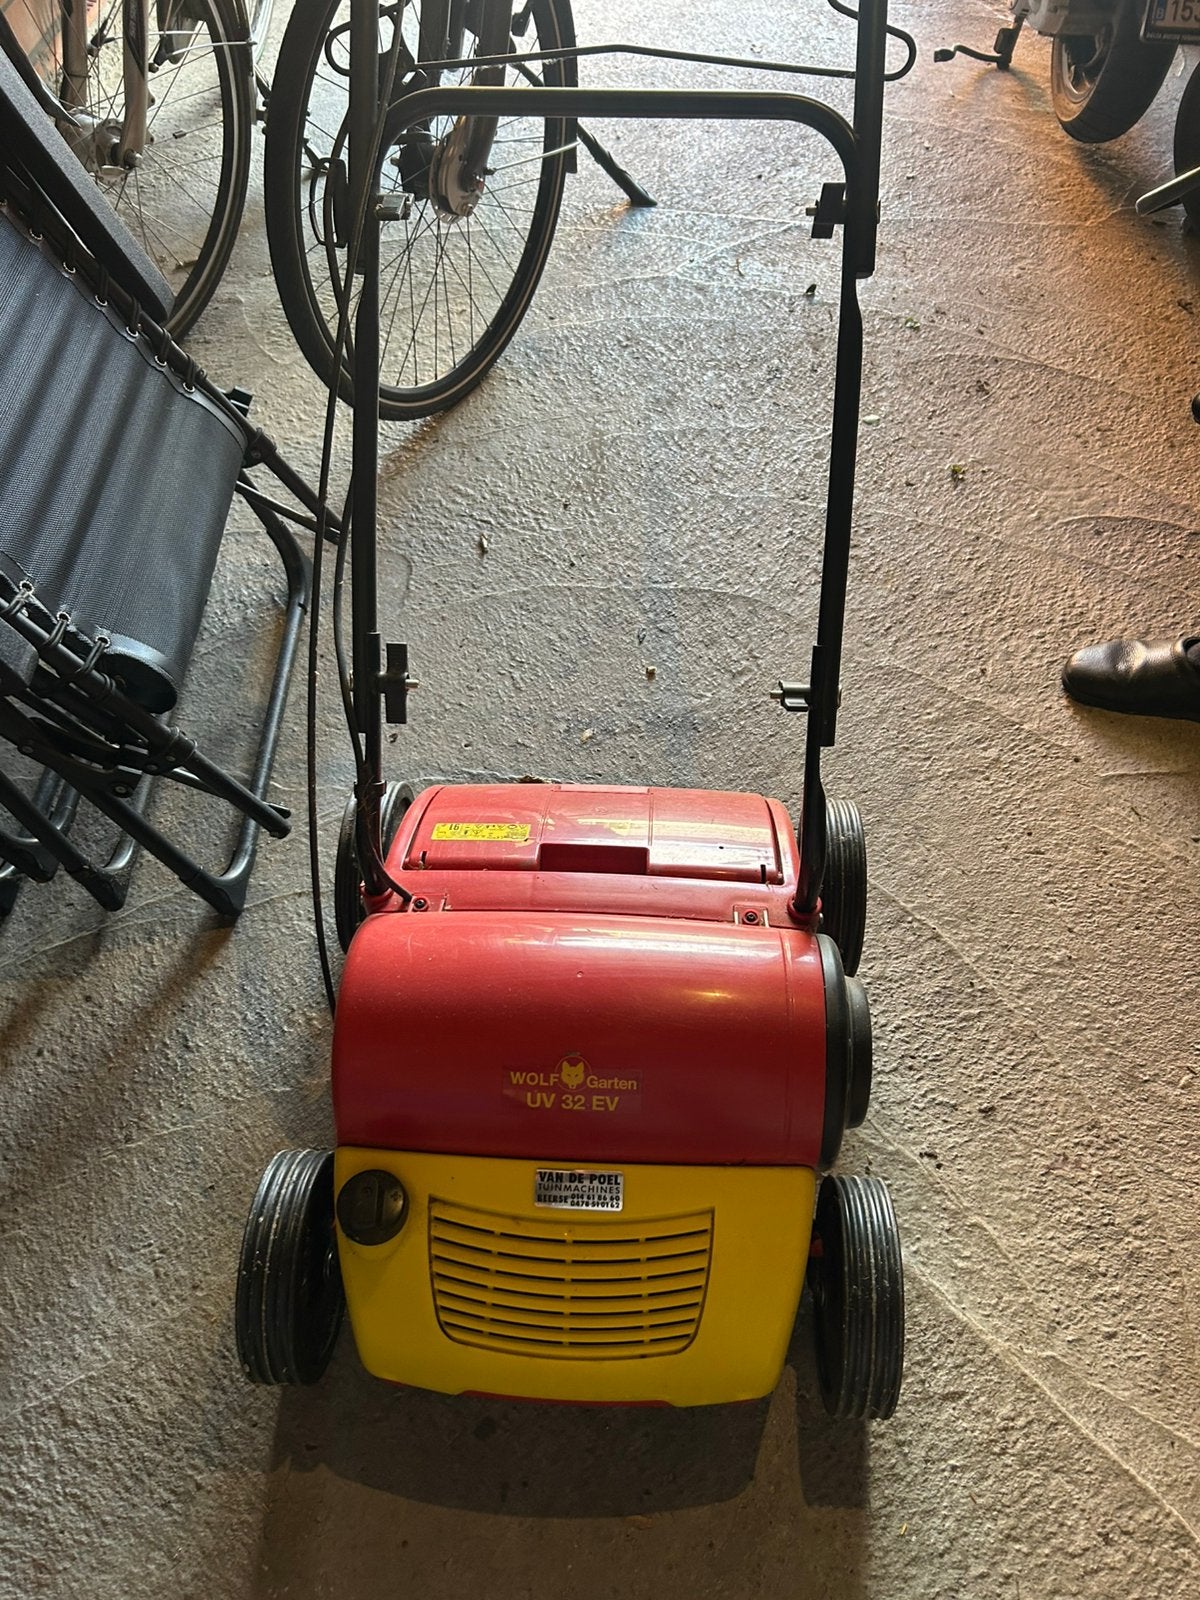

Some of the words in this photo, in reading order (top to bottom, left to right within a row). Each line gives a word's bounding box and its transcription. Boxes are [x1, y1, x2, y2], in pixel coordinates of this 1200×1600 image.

[510, 1071, 560, 1086] WOLF
[586, 1075, 638, 1090] Garten
[526, 1092, 556, 1108] UV
[561, 1094, 586, 1110] 32
[592, 1095, 620, 1111] EV
[539, 1171, 564, 1183] VAN
[568, 1172, 585, 1184] DE
[589, 1174, 621, 1186] POEL
[538, 1183, 620, 1194] TUINMACHINES
[537, 1194, 569, 1204] BEERSE
